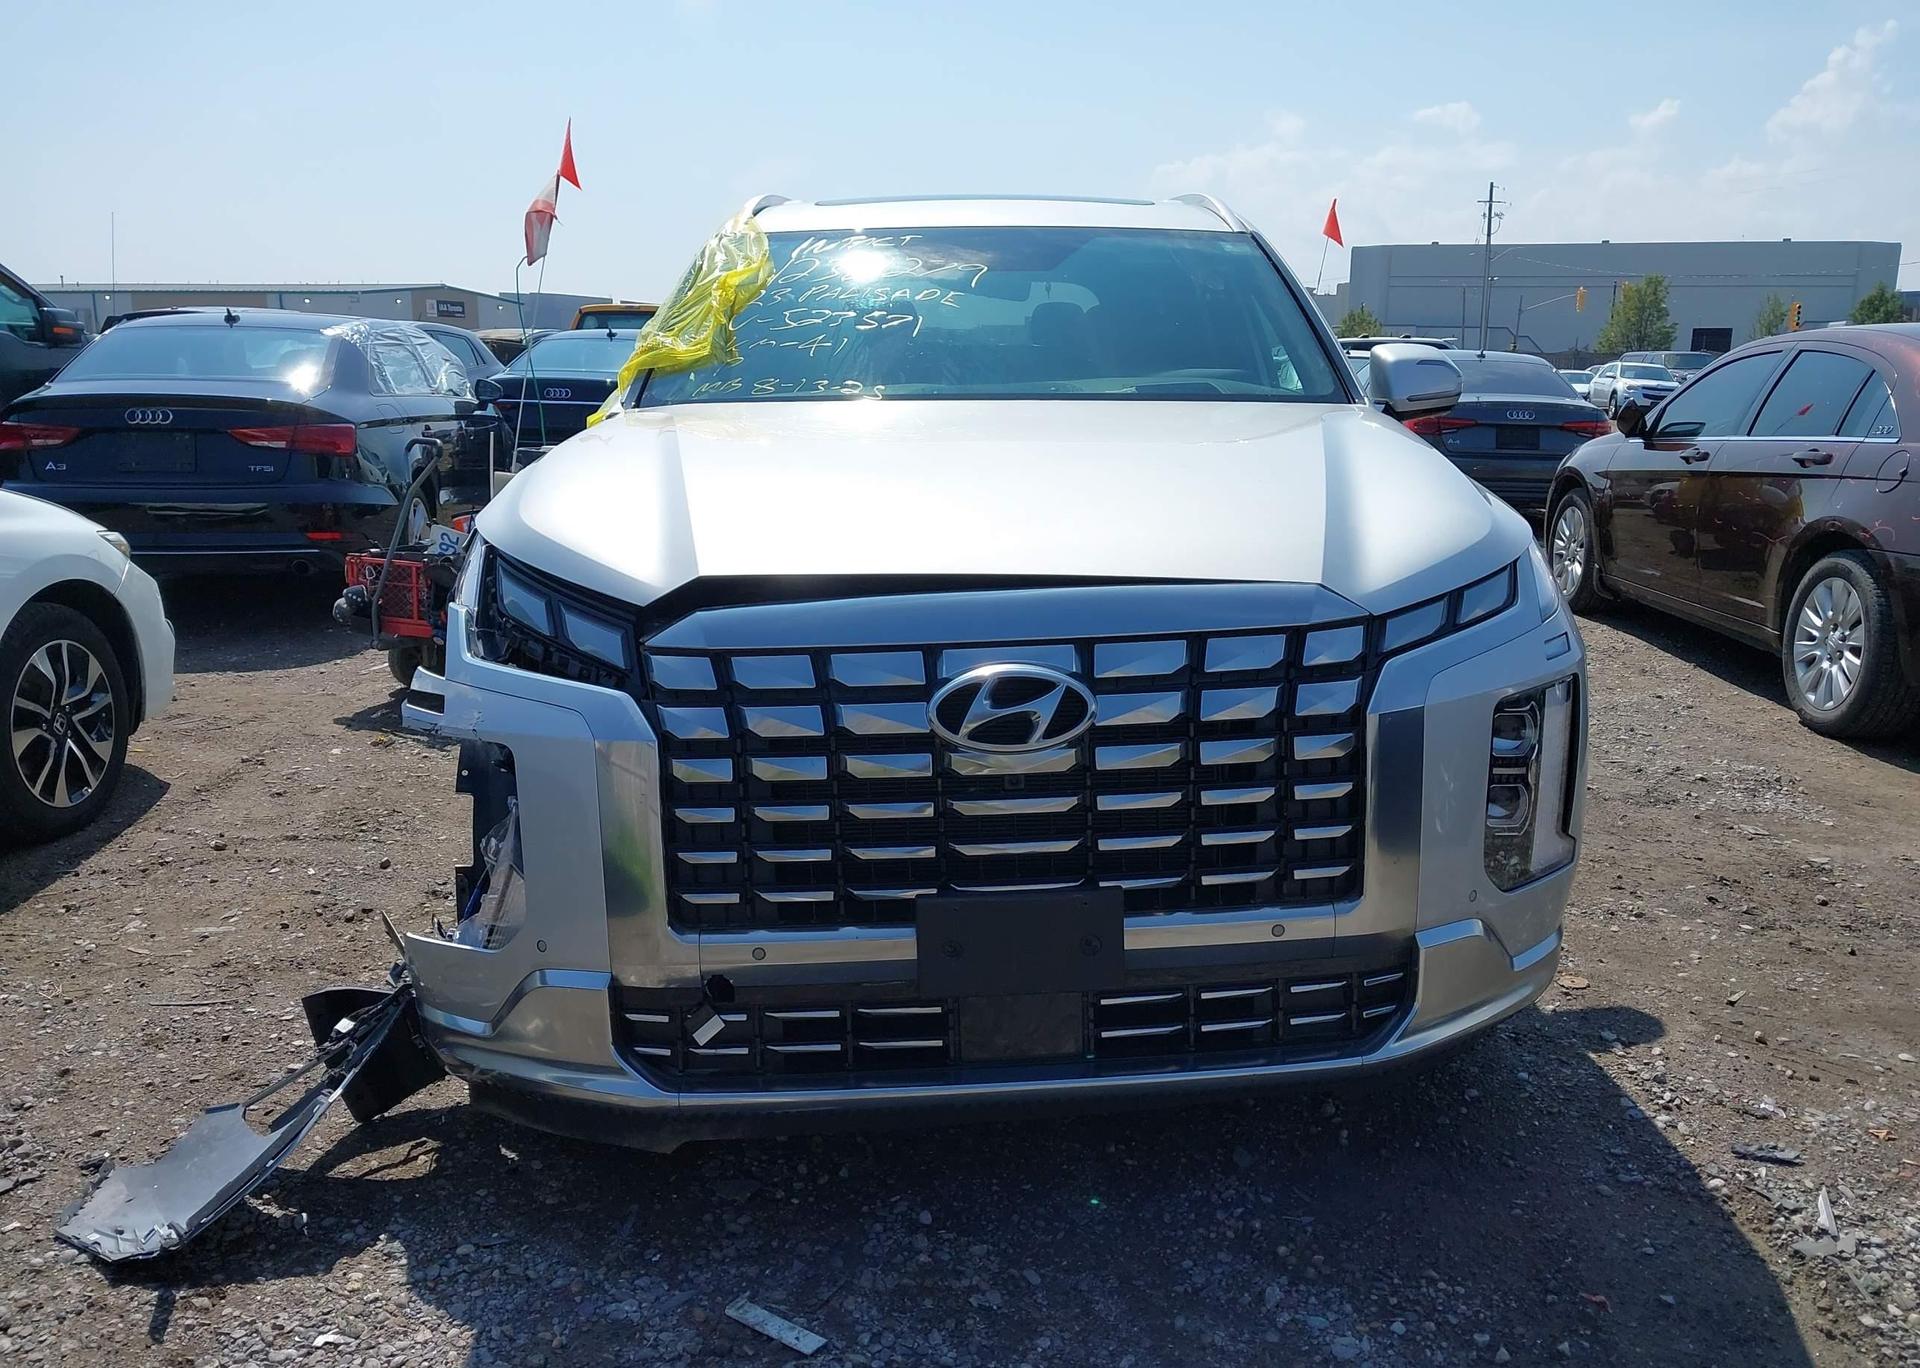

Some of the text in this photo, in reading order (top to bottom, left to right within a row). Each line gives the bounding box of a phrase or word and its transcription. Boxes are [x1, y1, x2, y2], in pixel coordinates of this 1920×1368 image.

[798, 284, 965, 308] PALISADE
[44, 460, 67, 472] A3
[248, 464, 275, 473] TFSI
